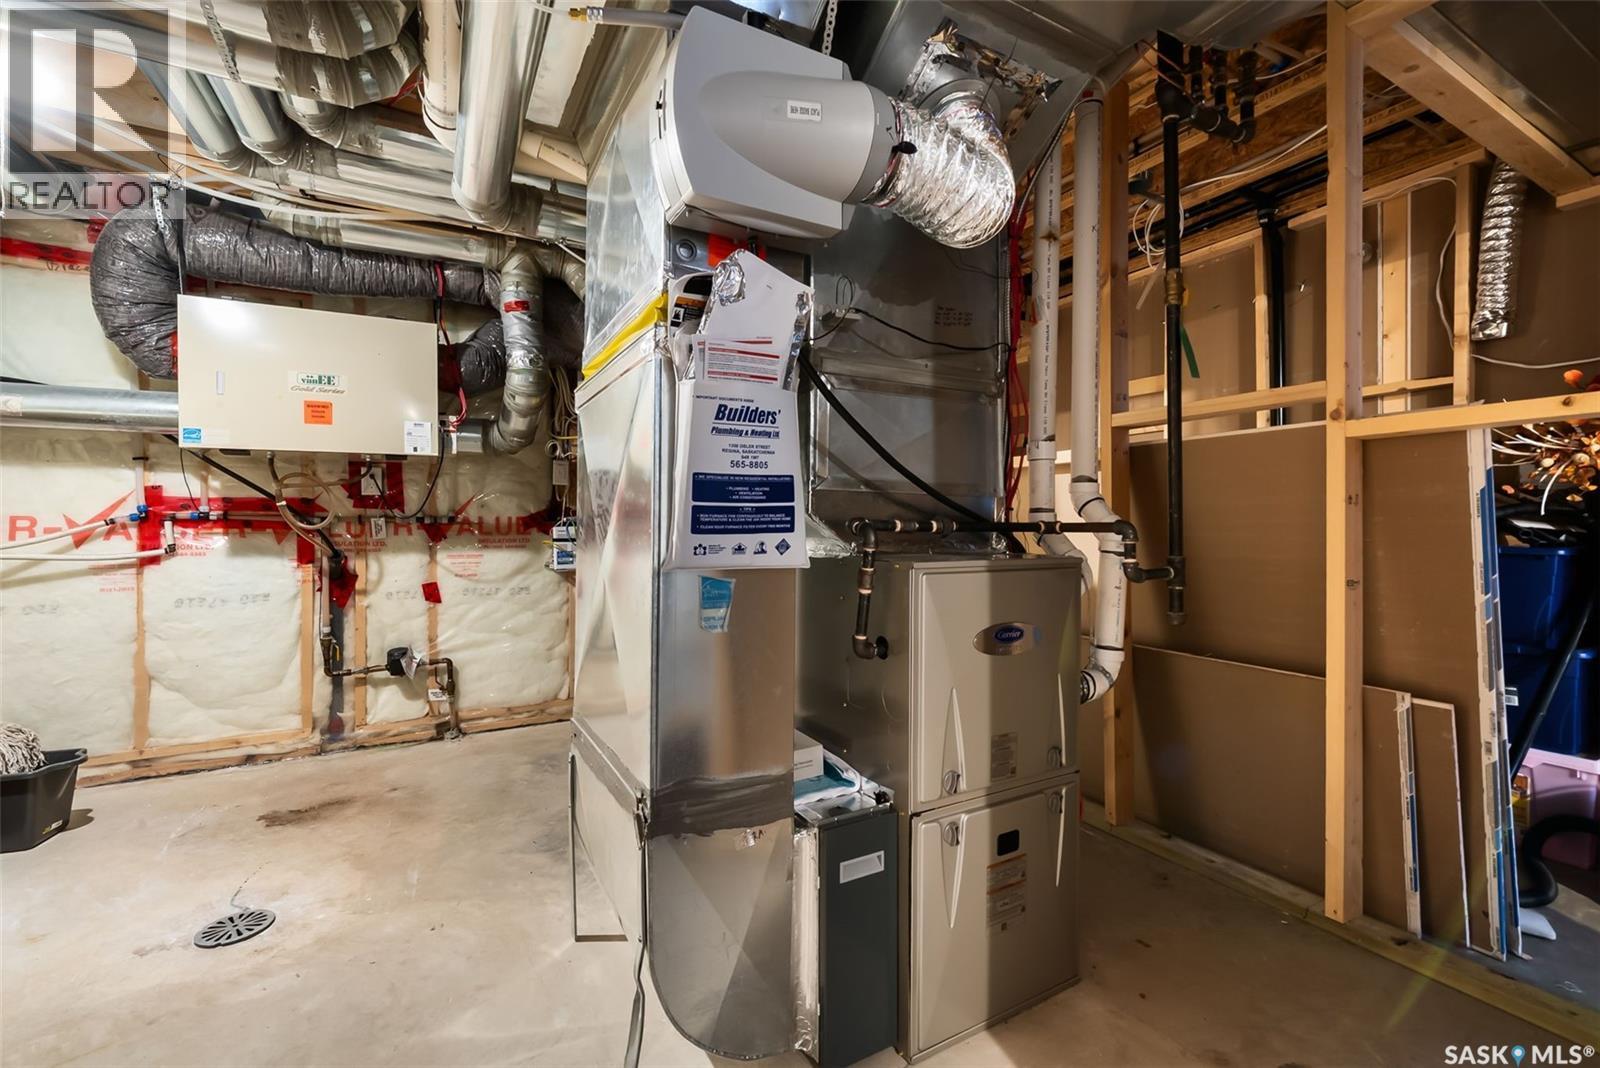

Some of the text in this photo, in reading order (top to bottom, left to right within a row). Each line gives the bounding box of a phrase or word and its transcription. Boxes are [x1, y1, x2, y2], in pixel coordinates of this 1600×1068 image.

[714, 403, 781, 425] Builders'
[711, 426, 744, 437] Plumbing
[750, 429, 772, 439] Heating
[730, 460, 769, 469] 565-8805
